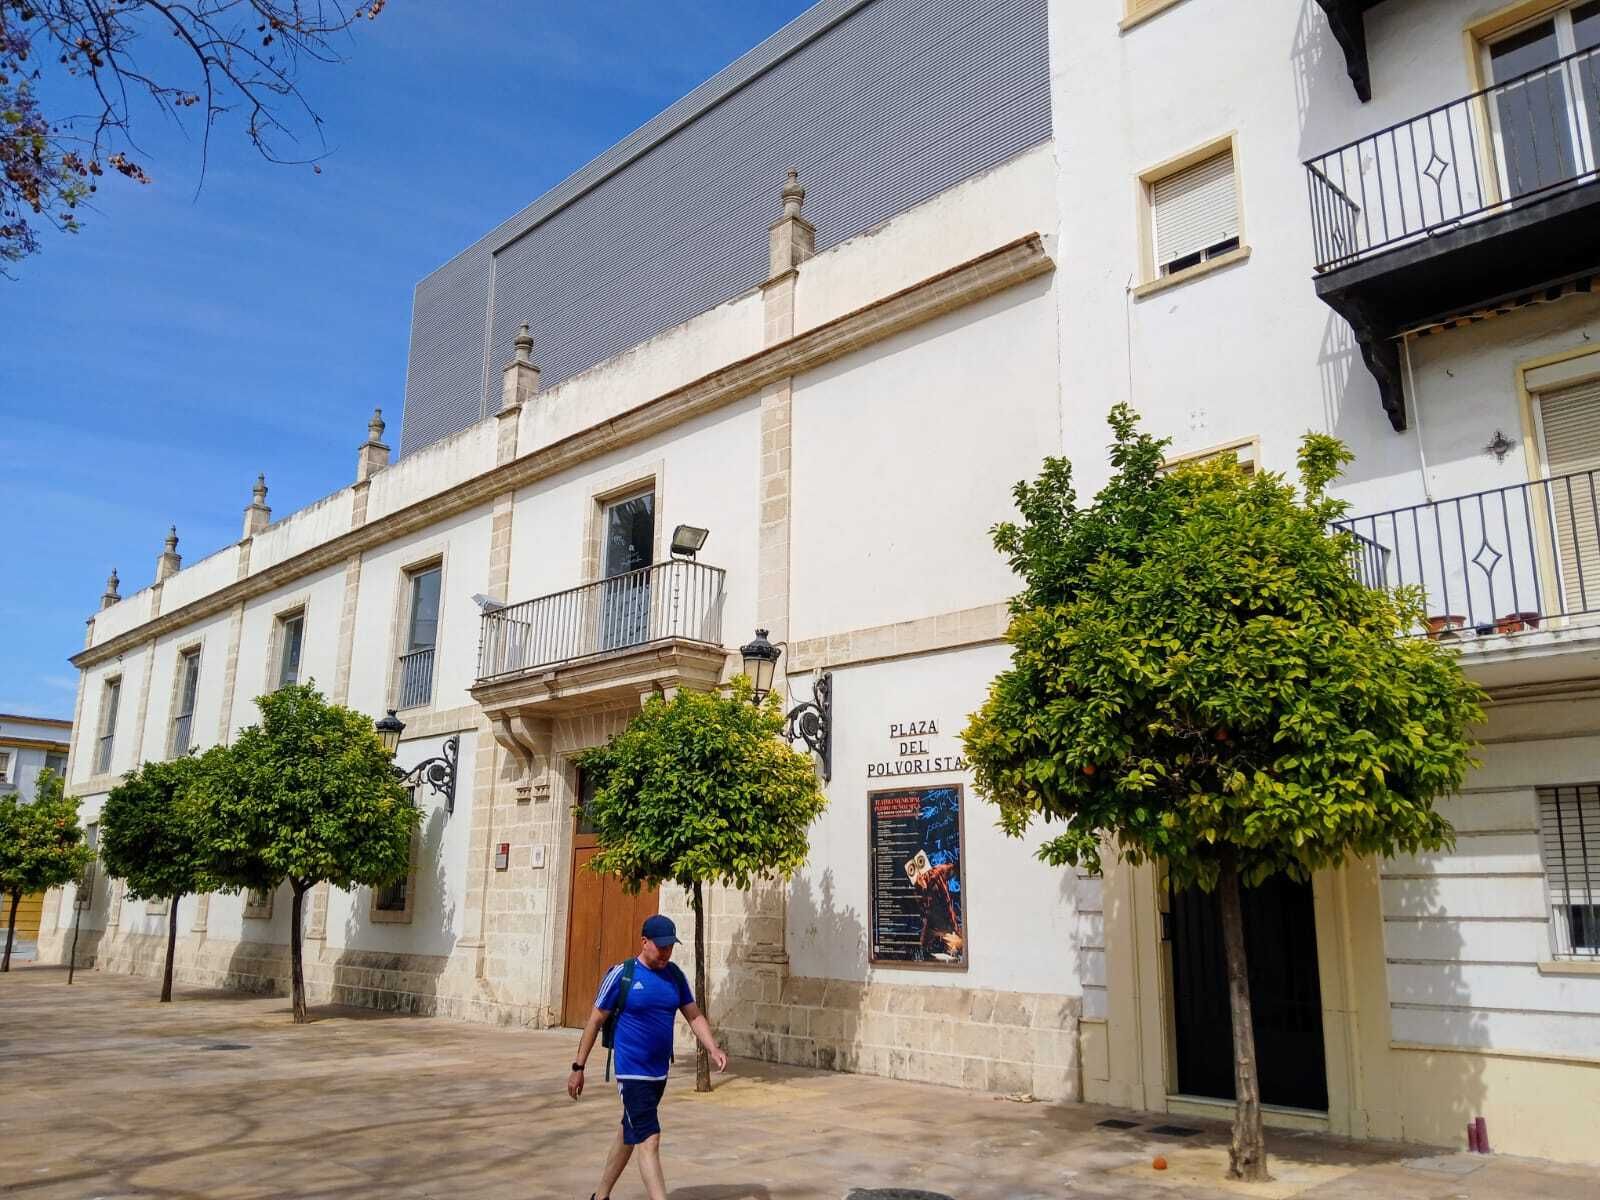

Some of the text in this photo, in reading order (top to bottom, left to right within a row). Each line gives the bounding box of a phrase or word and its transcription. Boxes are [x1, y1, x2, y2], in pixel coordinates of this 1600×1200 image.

[890, 720, 938, 738] PLAZA
[900, 741, 929, 755] DEL
[867, 756, 965, 777] POLVORISTA
